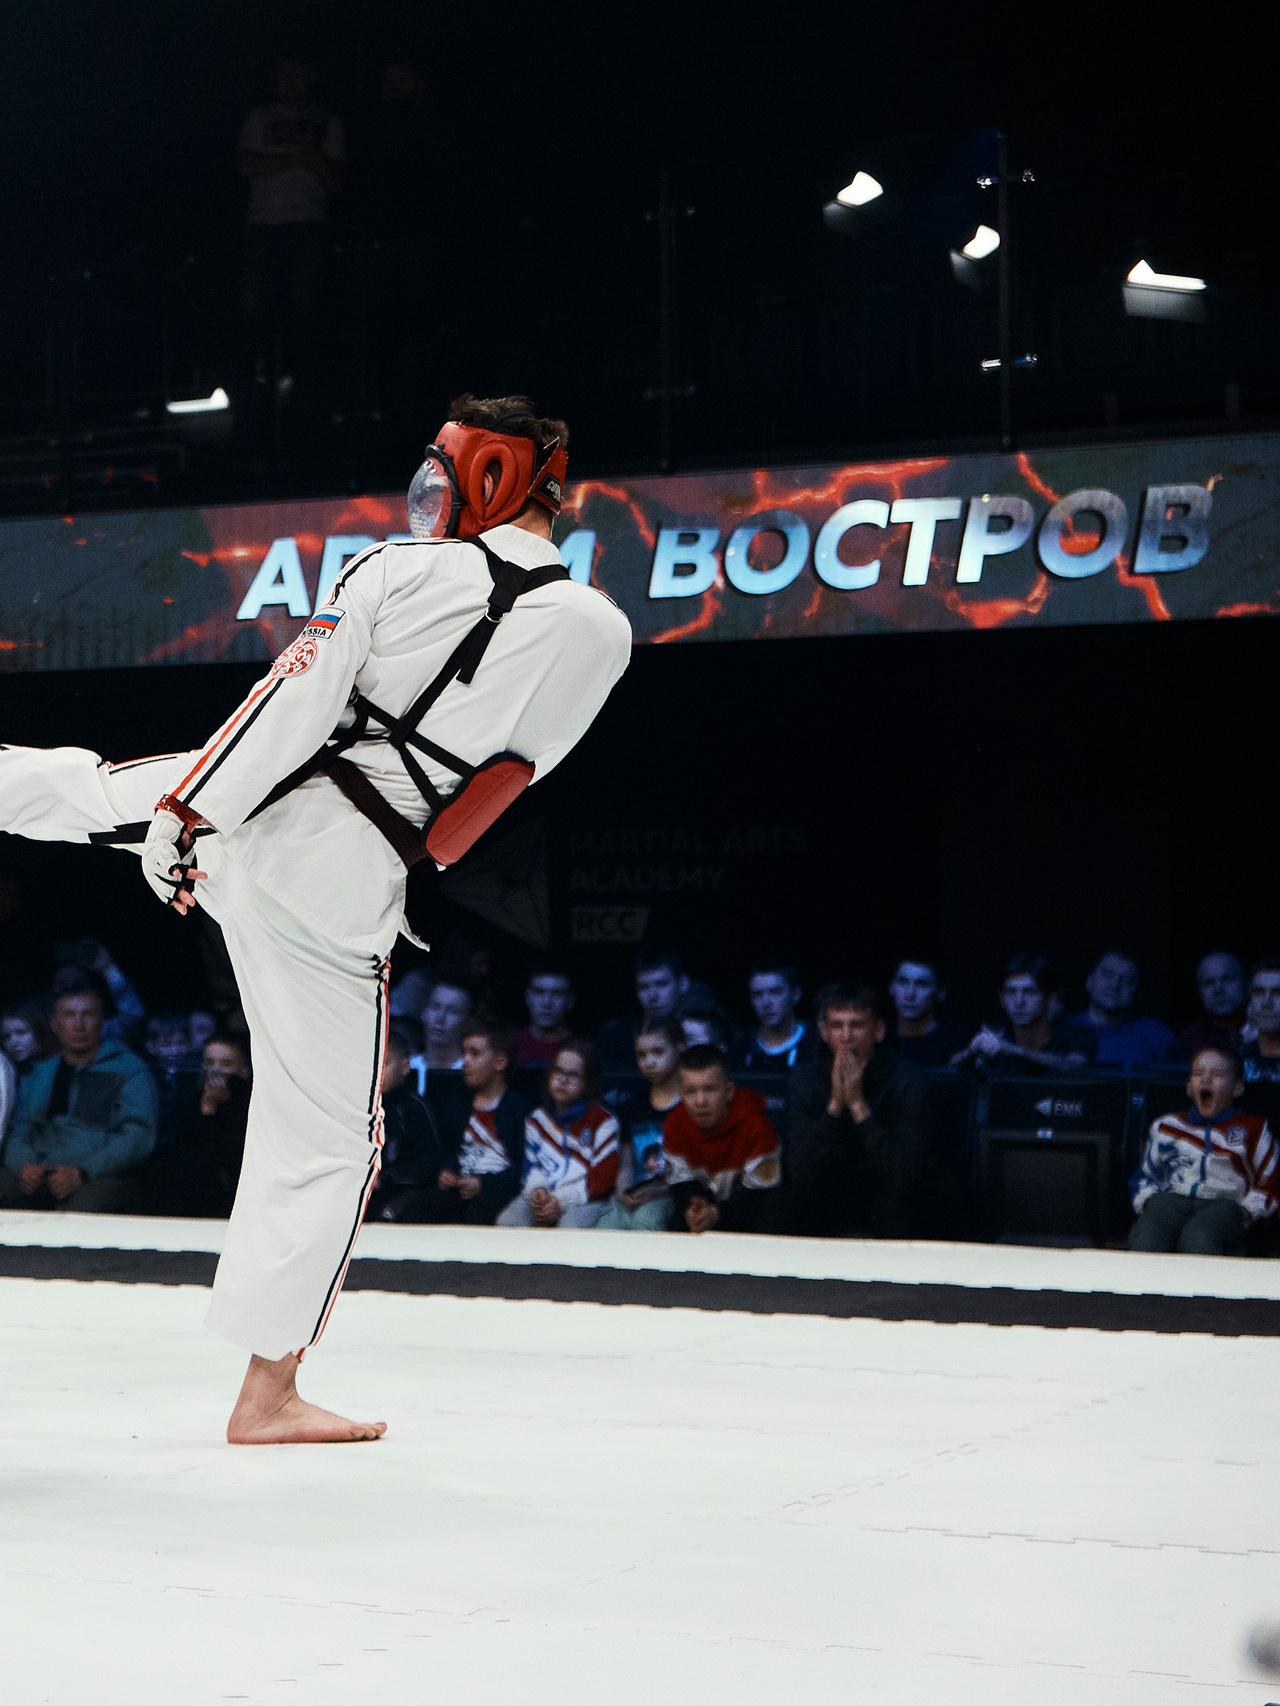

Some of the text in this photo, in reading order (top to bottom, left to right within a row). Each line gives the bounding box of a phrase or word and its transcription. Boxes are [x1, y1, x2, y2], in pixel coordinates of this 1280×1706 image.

[647, 484, 1215, 599] ВОСТРОВ
[569, 827, 808, 853] MARTIAL ARTS
[569, 865, 724, 890] ACADEMY
[576, 911, 637, 937] RCC
